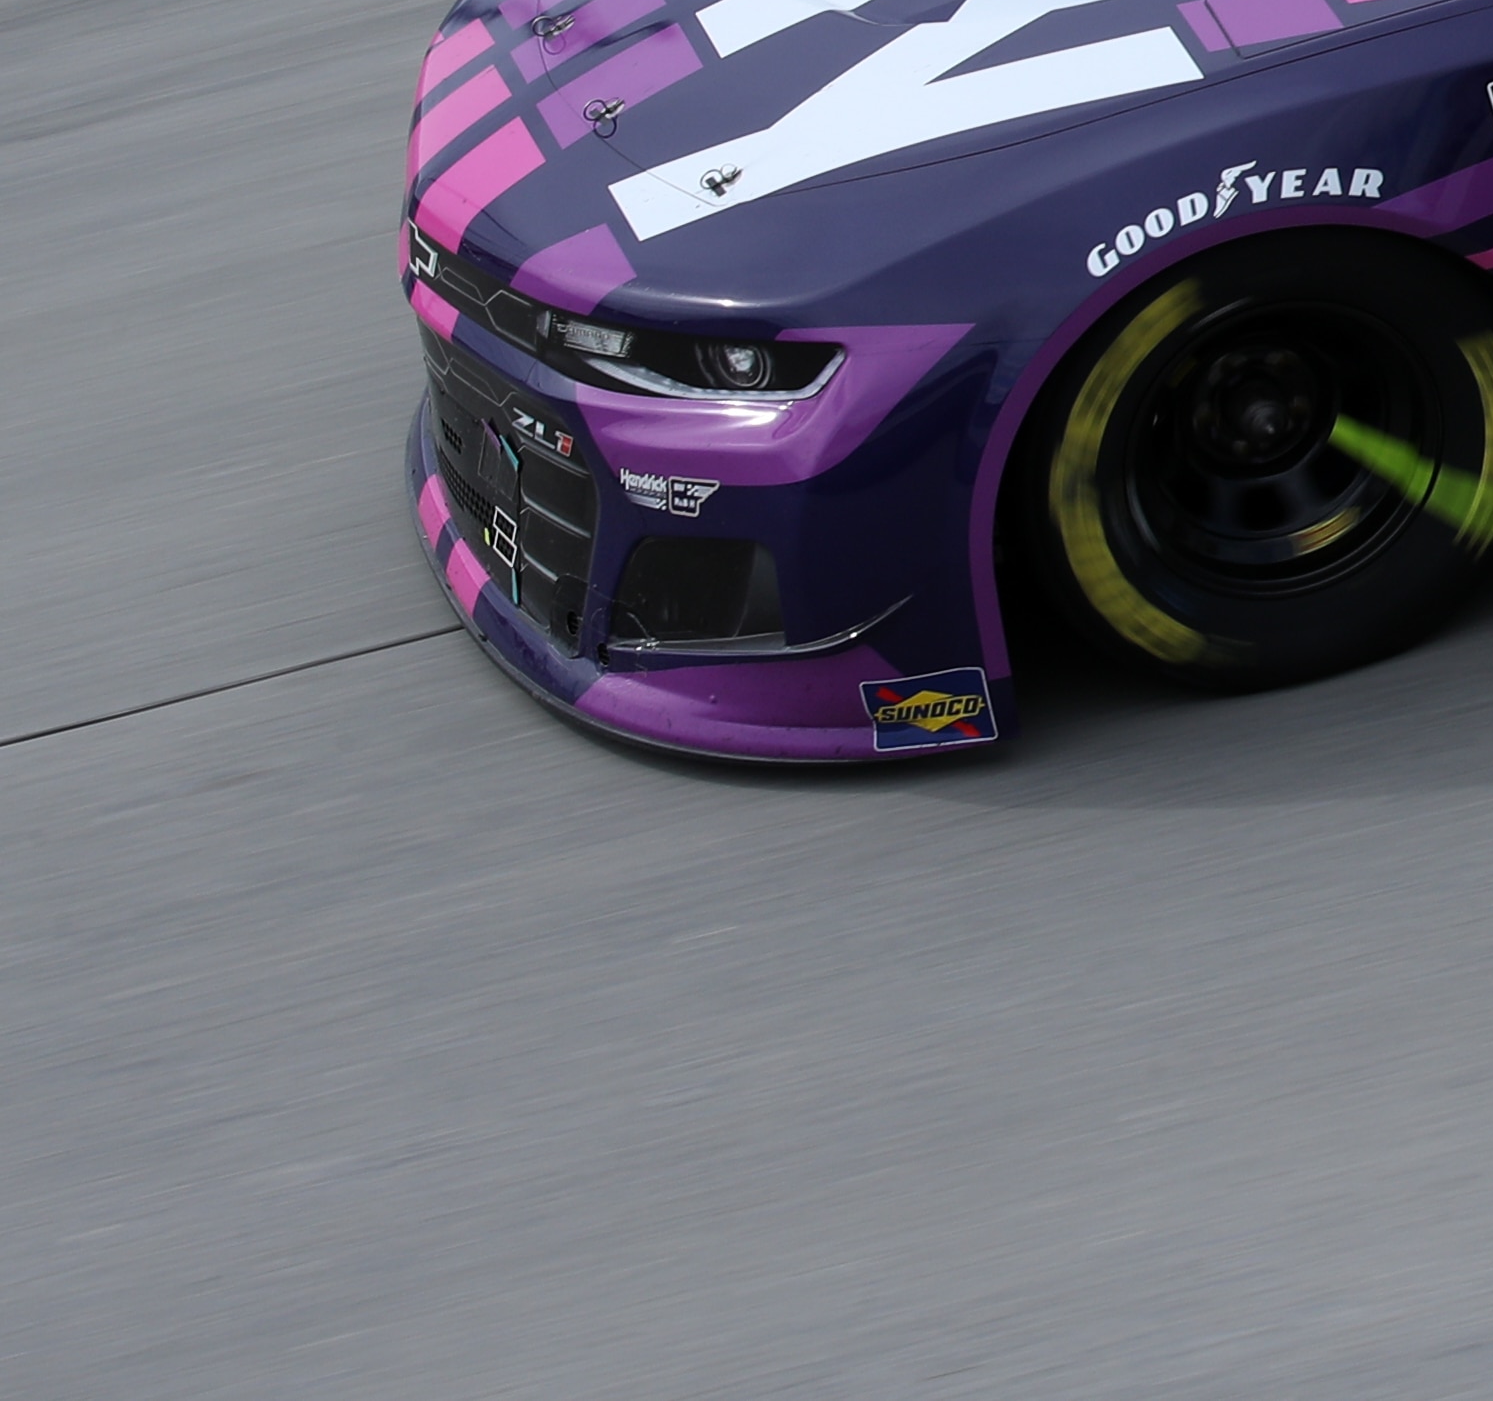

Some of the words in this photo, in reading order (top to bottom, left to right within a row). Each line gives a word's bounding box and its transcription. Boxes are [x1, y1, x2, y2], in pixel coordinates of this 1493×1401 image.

[1087, 162, 1385, 277] GOODYEAR
[512, 407, 574, 457] ZL1
[879, 696, 982, 722] SUNOCO
